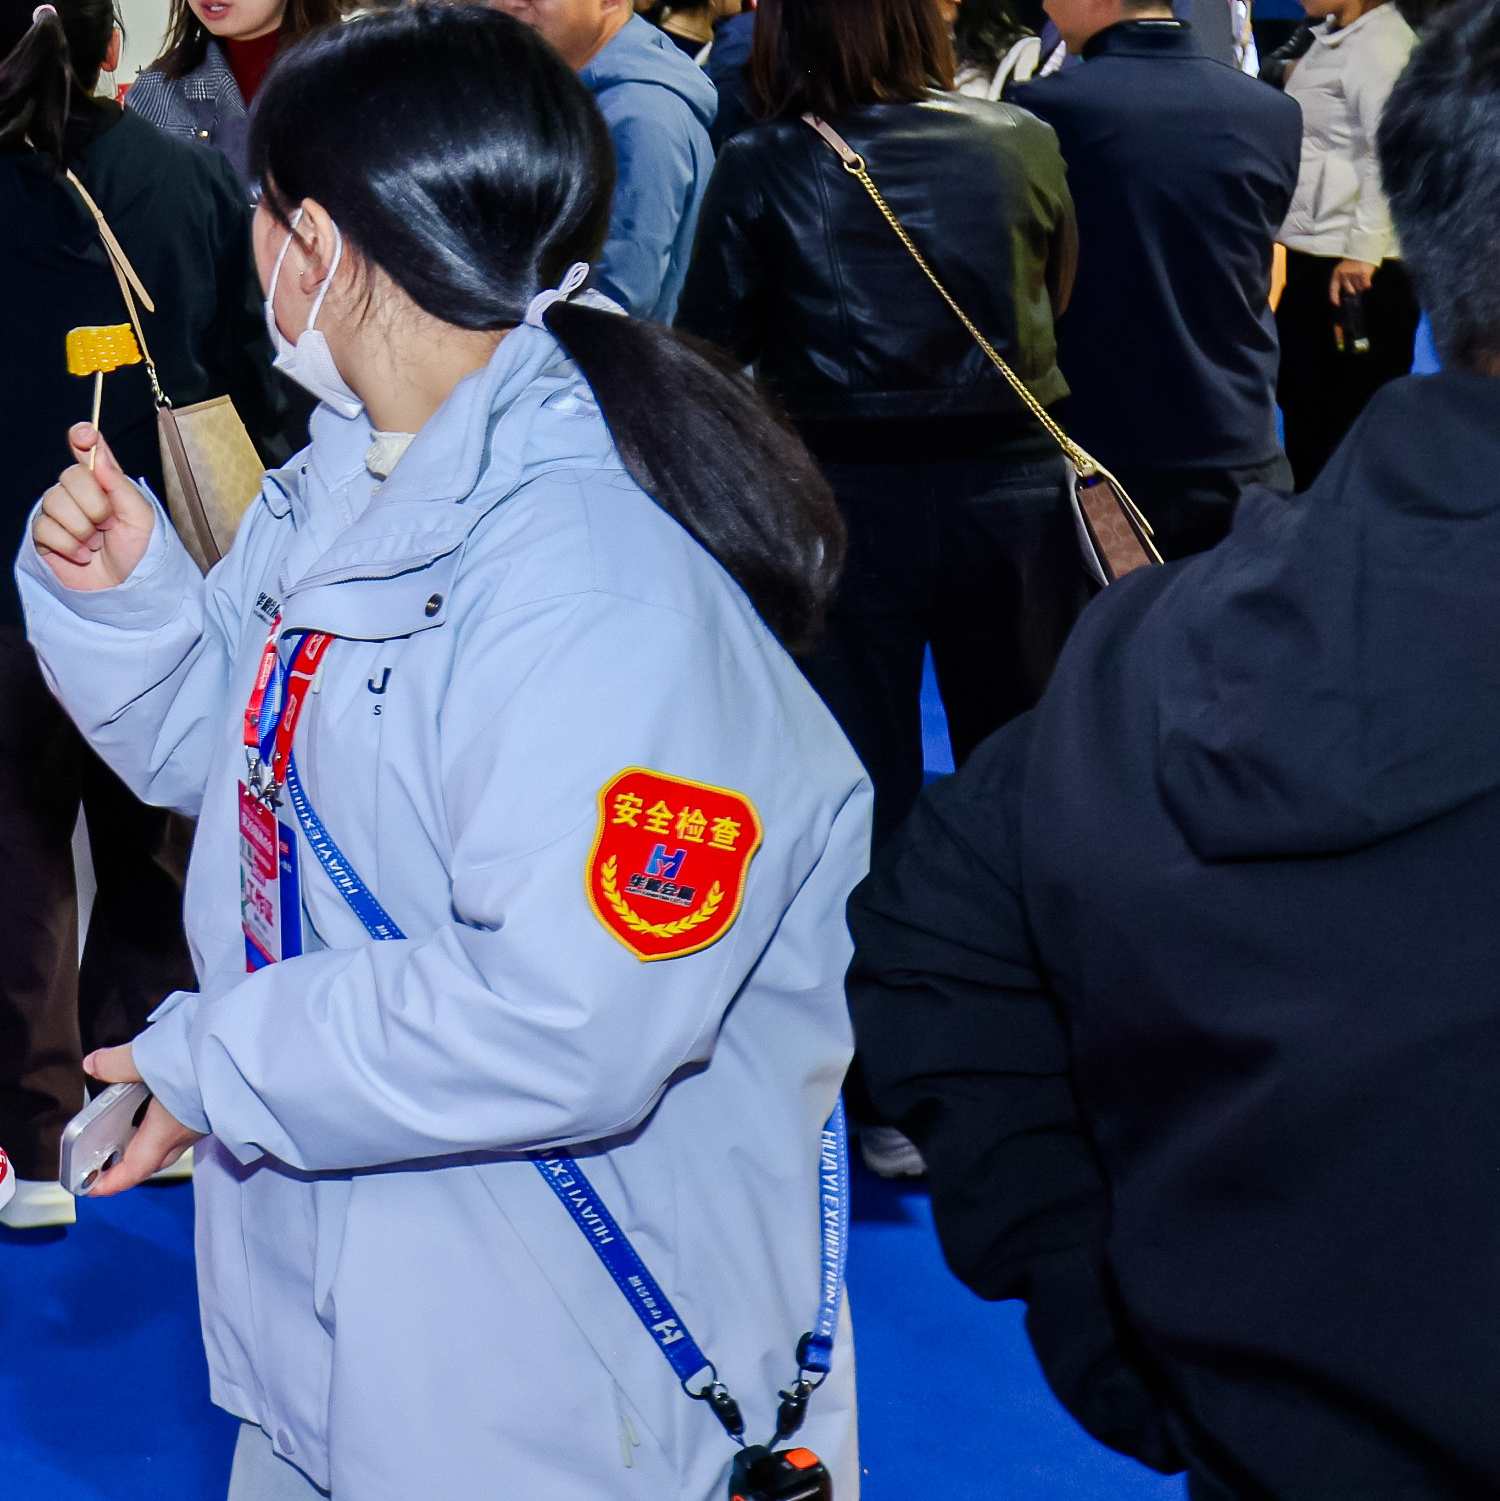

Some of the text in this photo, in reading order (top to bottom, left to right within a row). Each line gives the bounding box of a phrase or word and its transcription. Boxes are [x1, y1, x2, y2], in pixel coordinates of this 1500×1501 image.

[367, 666, 392, 695] J
[611, 791, 742, 852] 安全检查
[317, 842, 360, 895] HUAYI
[567, 1187, 615, 1245] HUAYI
